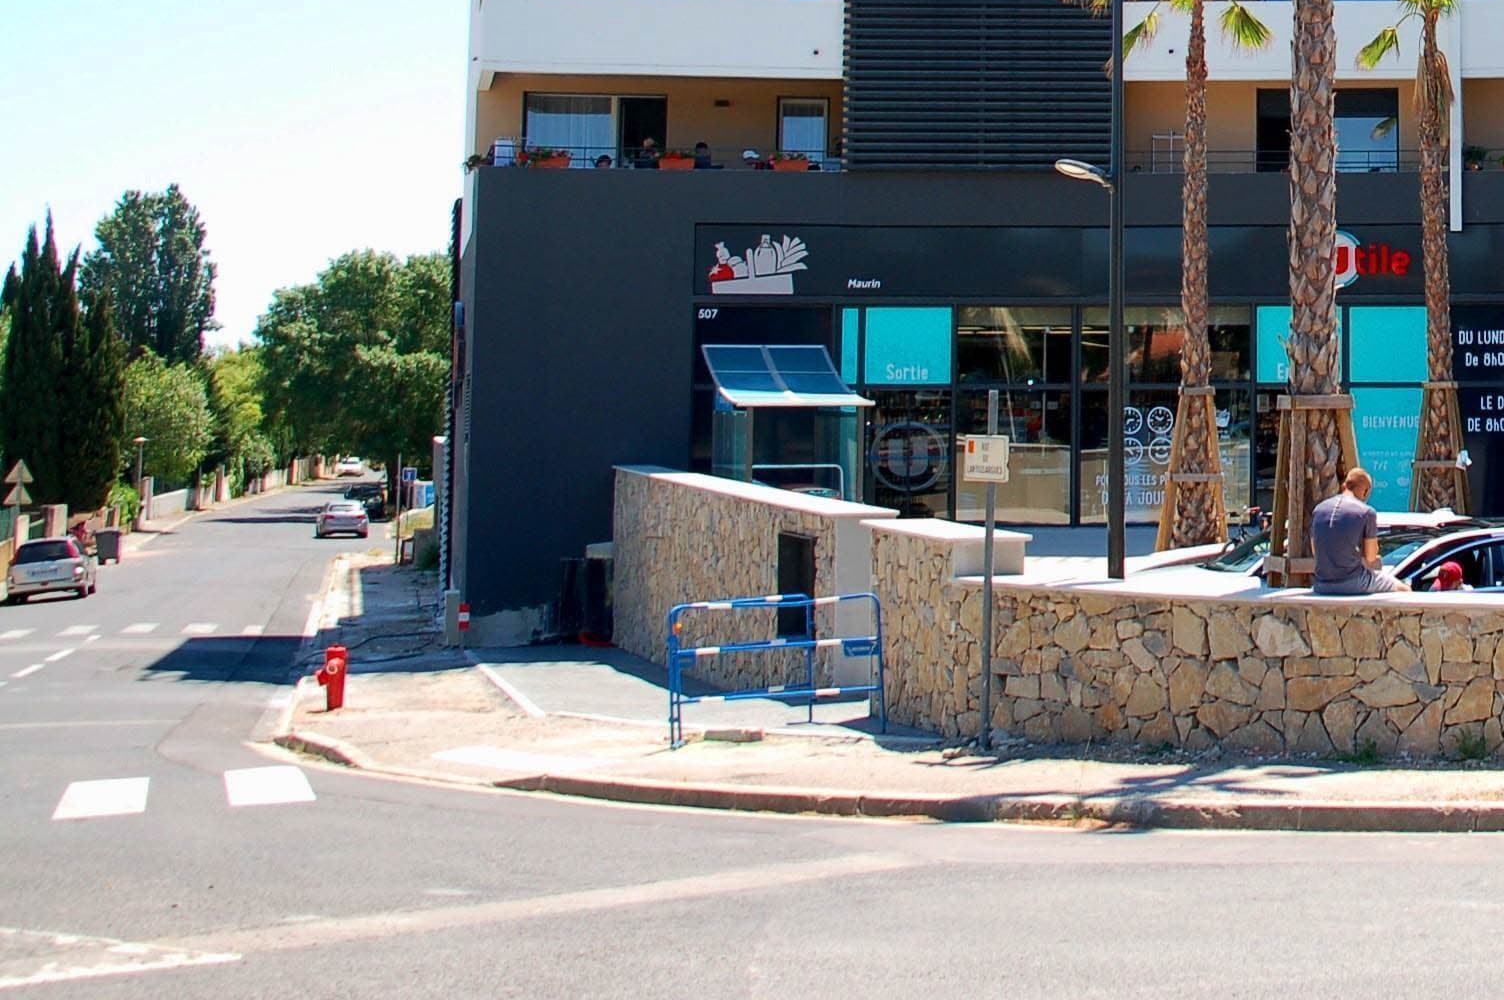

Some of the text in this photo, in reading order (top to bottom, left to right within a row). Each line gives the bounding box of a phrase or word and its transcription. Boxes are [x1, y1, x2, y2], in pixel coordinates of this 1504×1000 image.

[847, 278, 881, 289] Maurin
[697, 308, 718, 320] 507
[1458, 330, 1474, 345] DU
[1465, 351, 1479, 367] De
[885, 362, 929, 381] Sortie
[1480, 395, 1493, 410] LE
[1467, 417, 1481, 432] DE
[1137, 490, 1166, 505] JOU
